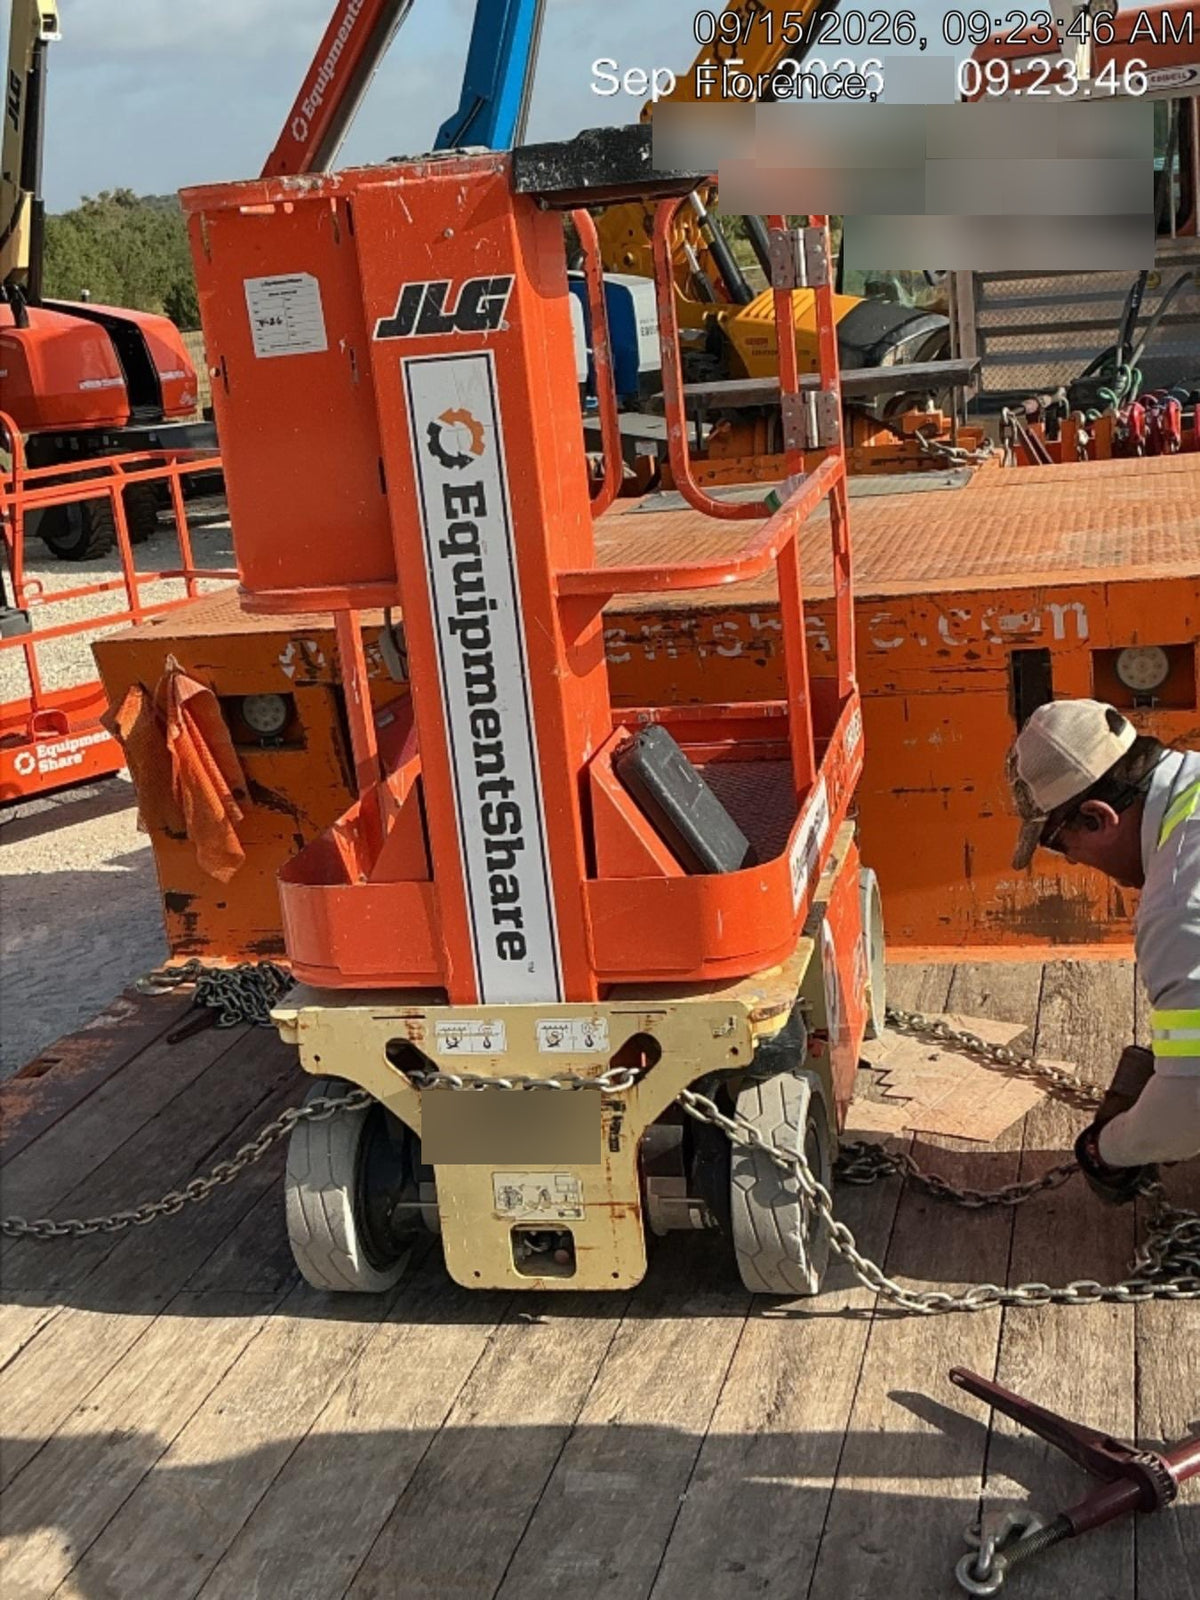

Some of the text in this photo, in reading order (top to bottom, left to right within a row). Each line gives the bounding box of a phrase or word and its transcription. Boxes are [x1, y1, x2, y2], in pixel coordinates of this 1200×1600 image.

[8, 68, 21, 133] JLG
[371, 274, 516, 341] JLG
[438, 481, 528, 962] EquipmentShare
[38, 752, 84, 774] Share
